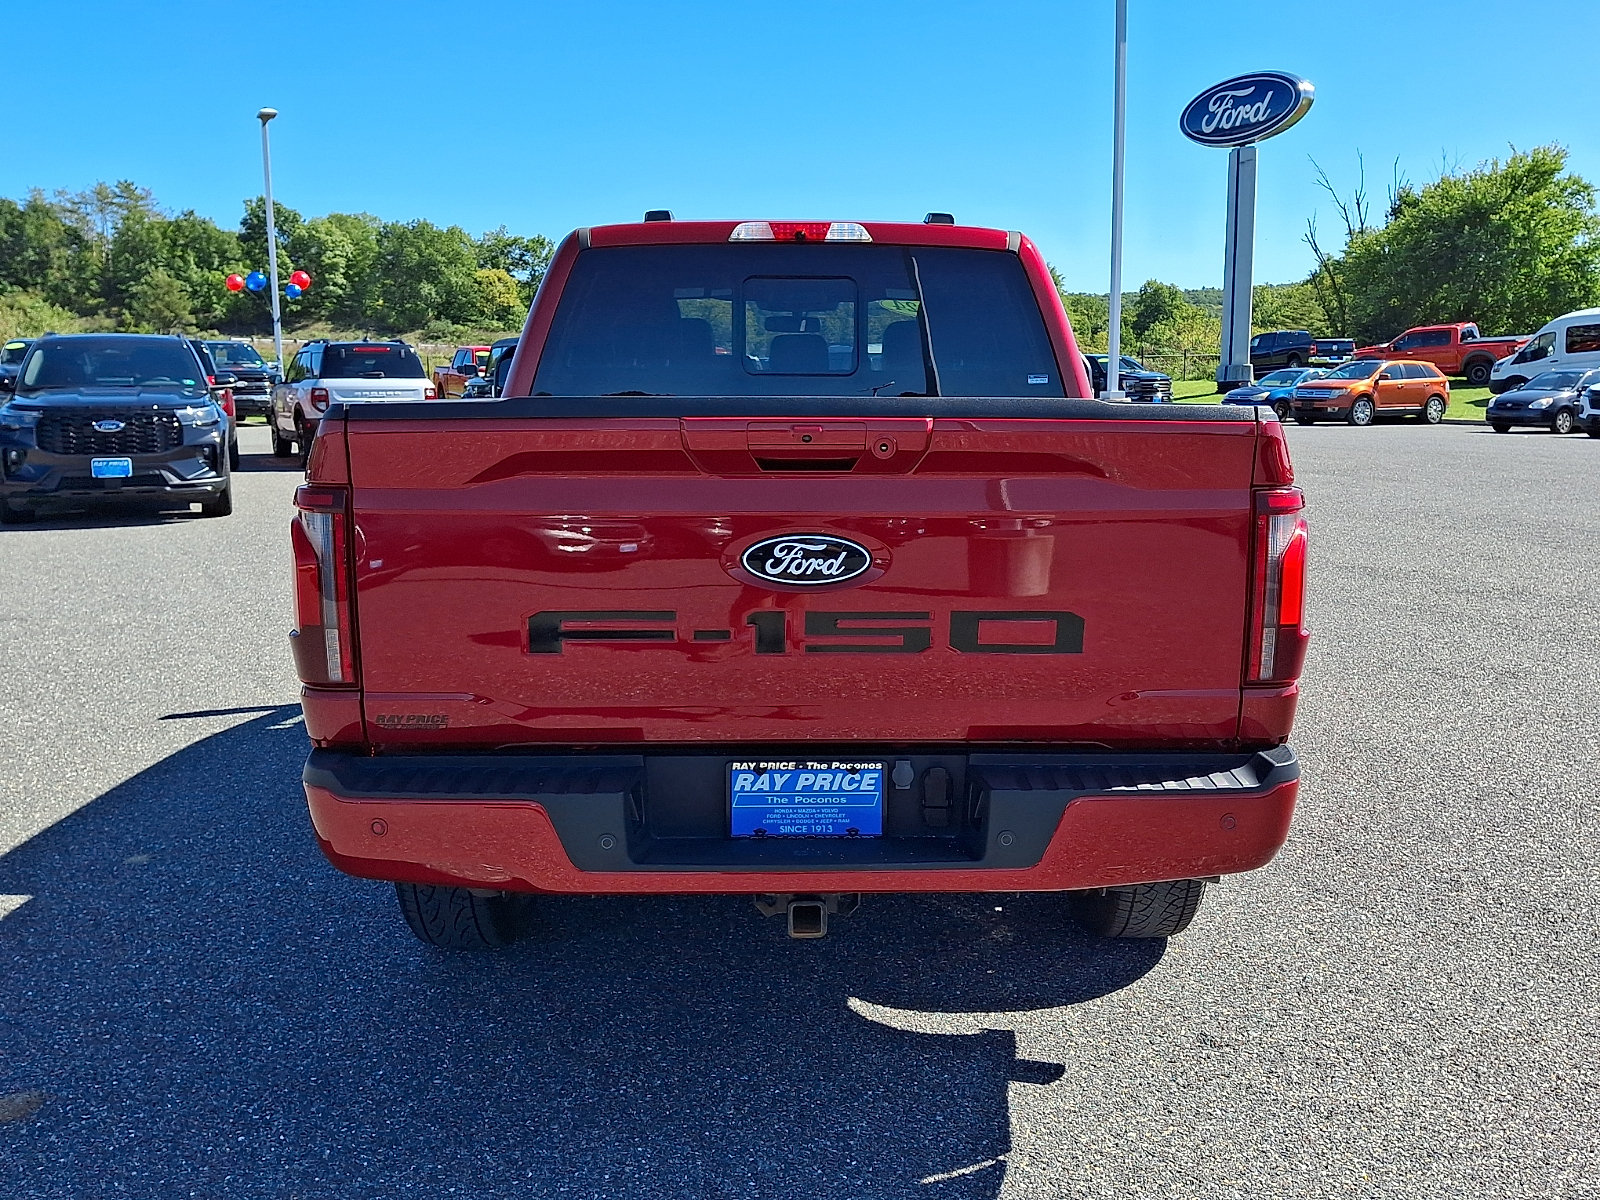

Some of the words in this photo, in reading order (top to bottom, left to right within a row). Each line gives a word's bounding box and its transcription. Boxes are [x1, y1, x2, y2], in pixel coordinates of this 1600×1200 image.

[1201, 86, 1274, 134] Ford
[765, 542, 847, 575] Ford
[527, 610, 1085, 654] F-150
[376, 714, 404, 723] RAY
[406, 714, 449, 723] PRICE
[732, 762, 757, 770] RAY
[759, 762, 796, 770] PRICE
[806, 762, 828, 770] The
[831, 762, 883, 770] Poconos
[734, 773, 791, 791] RAY
[795, 773, 879, 791] PRICE
[765, 796, 789, 804] The
[794, 796, 847, 804] Poconos
[779, 825, 808, 833] SINCE
[811, 824, 833, 833] 1913
